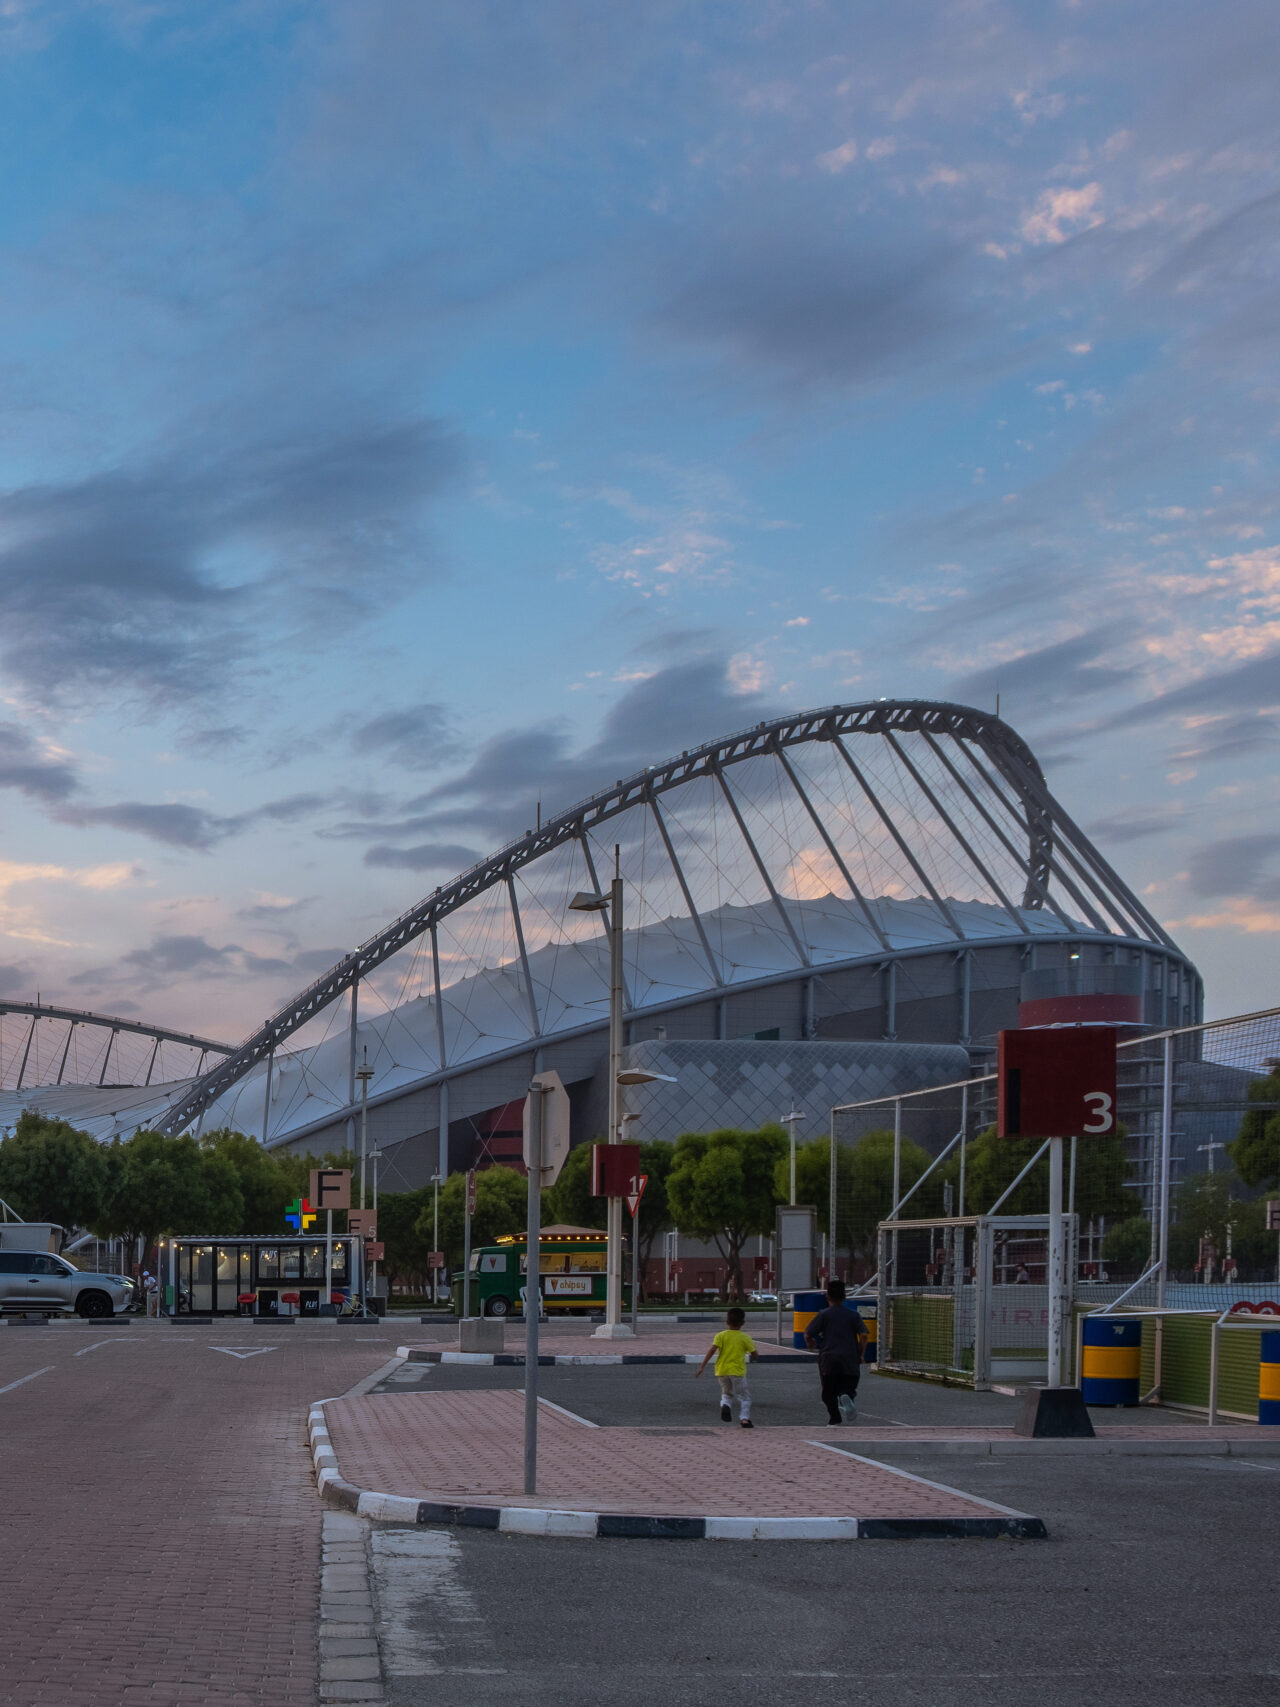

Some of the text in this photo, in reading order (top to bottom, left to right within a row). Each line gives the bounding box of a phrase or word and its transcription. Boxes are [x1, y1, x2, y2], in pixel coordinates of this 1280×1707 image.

[1082, 1091, 1113, 1133] 3
[317, 1171, 343, 1207] F
[629, 1175, 639, 1195] 1
[349, 1218, 377, 1238] F 5
[367, 1248, 376, 1260] F
